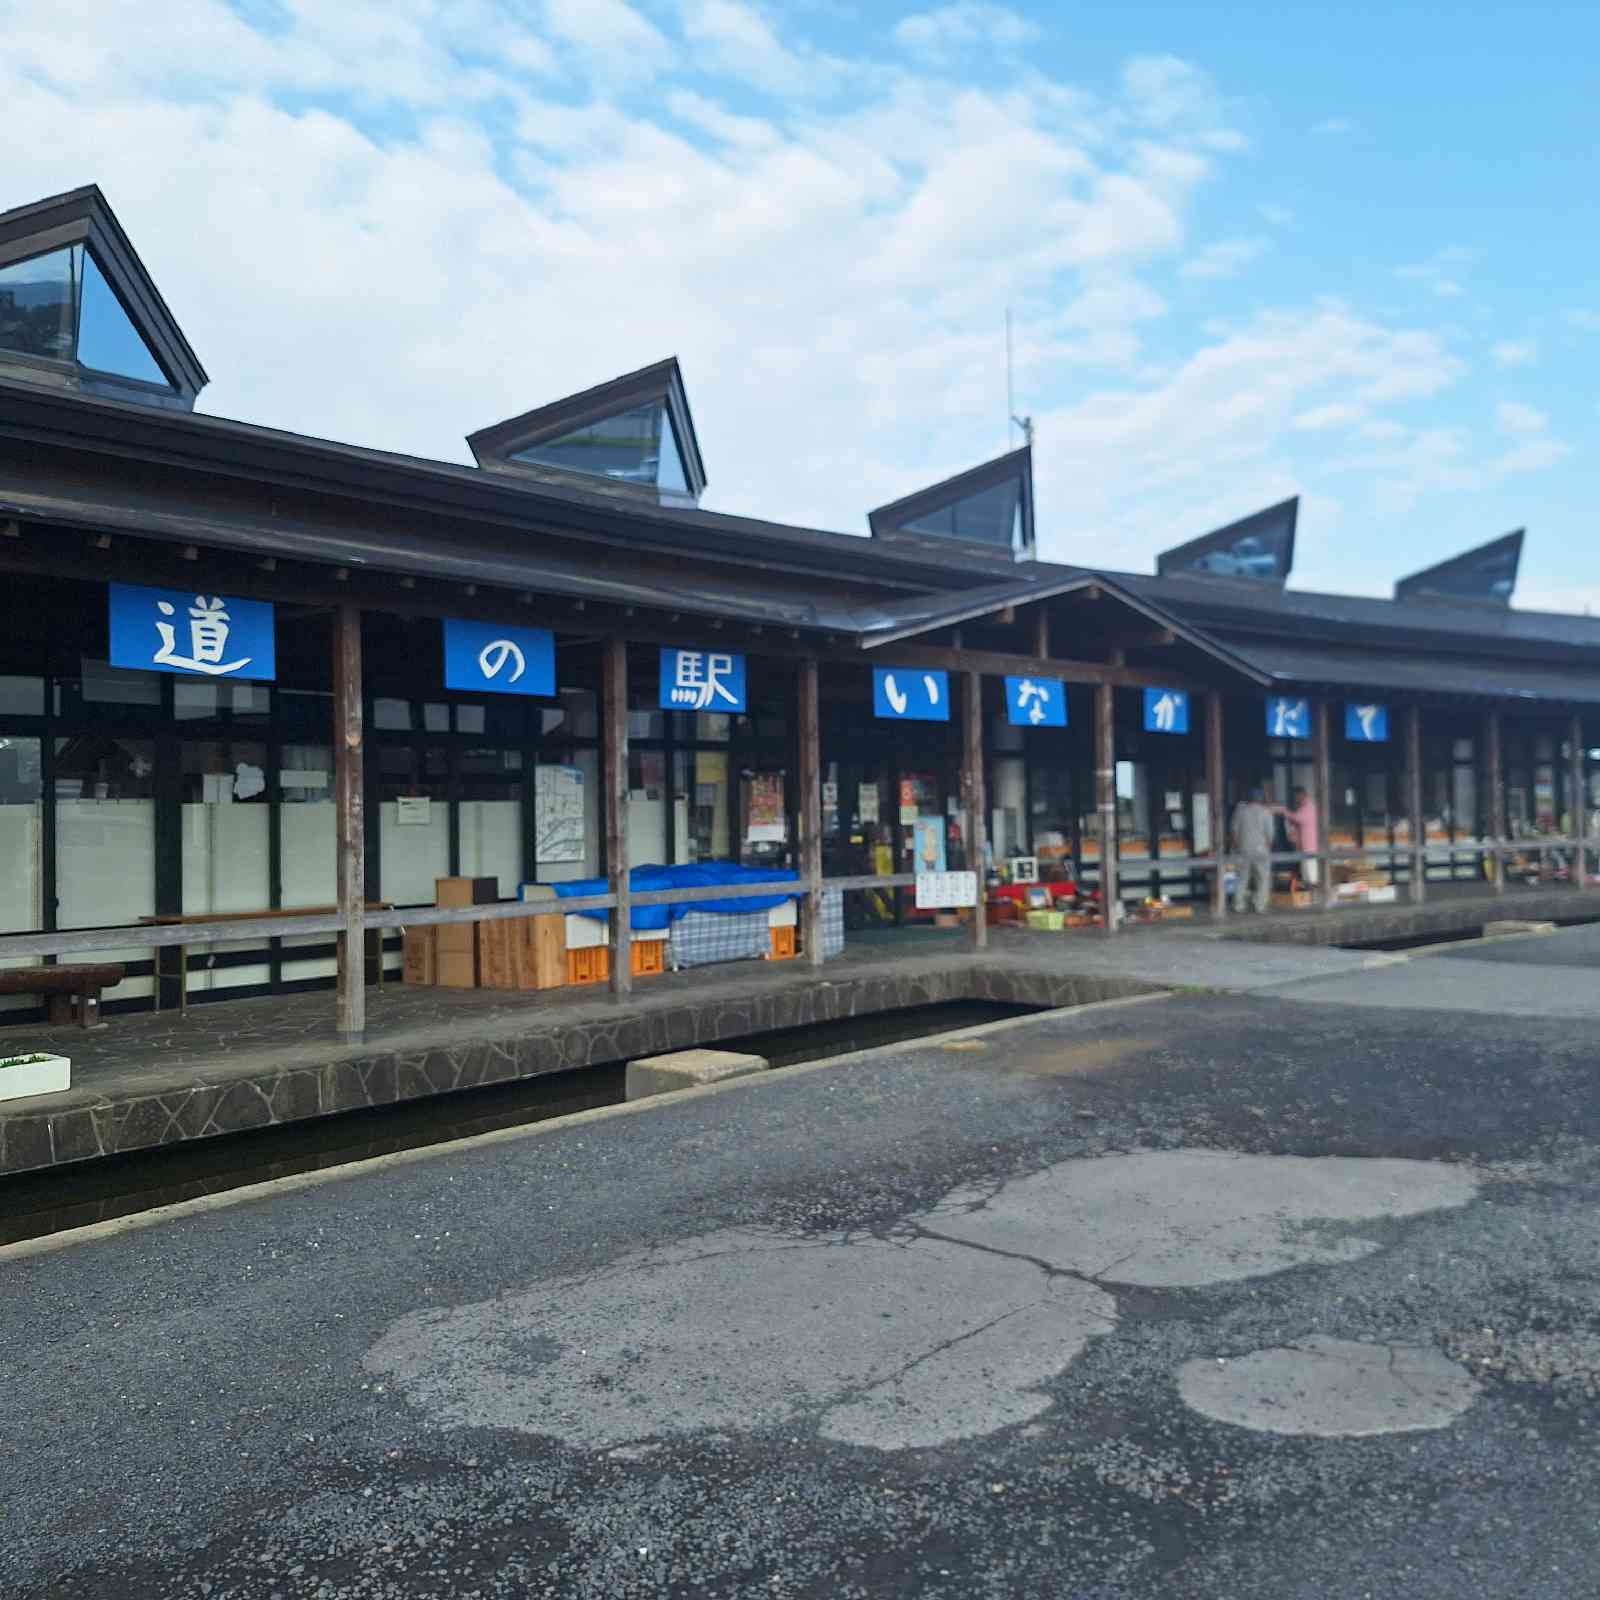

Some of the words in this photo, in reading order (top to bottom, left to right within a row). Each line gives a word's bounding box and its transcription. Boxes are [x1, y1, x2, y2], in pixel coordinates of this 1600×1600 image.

[153, 595, 252, 675] 道
[479, 639, 525, 683] の
[671, 651, 738, 710] 駅
[884, 674, 939, 714] い
[1017, 679, 1049, 725] な
[1152, 694, 1183, 730] が
[1274, 699, 1303, 736] だ
[1355, 705, 1377, 740] て
